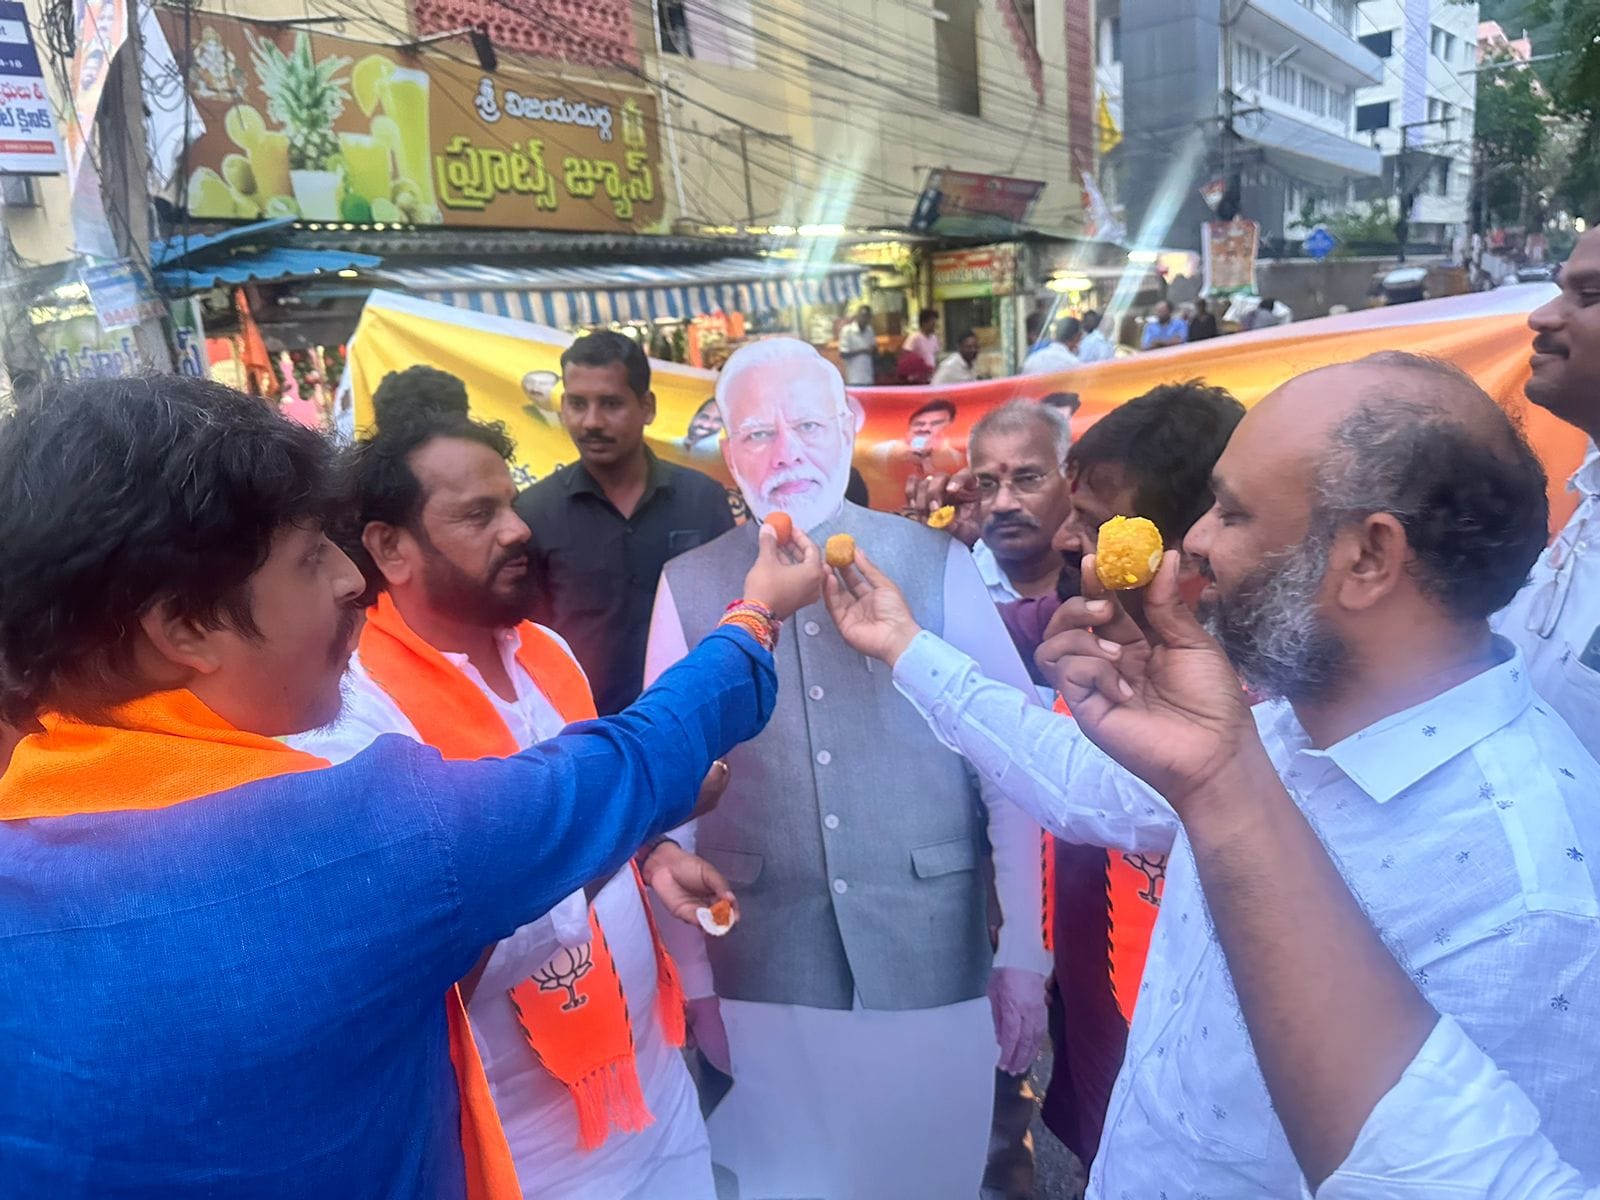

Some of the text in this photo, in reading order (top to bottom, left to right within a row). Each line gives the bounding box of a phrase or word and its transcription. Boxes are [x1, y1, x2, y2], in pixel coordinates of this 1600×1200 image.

[474, 77, 613, 143] శ్రీ విజయదుర్గ
[563, 151, 654, 219] జ్యూస్
